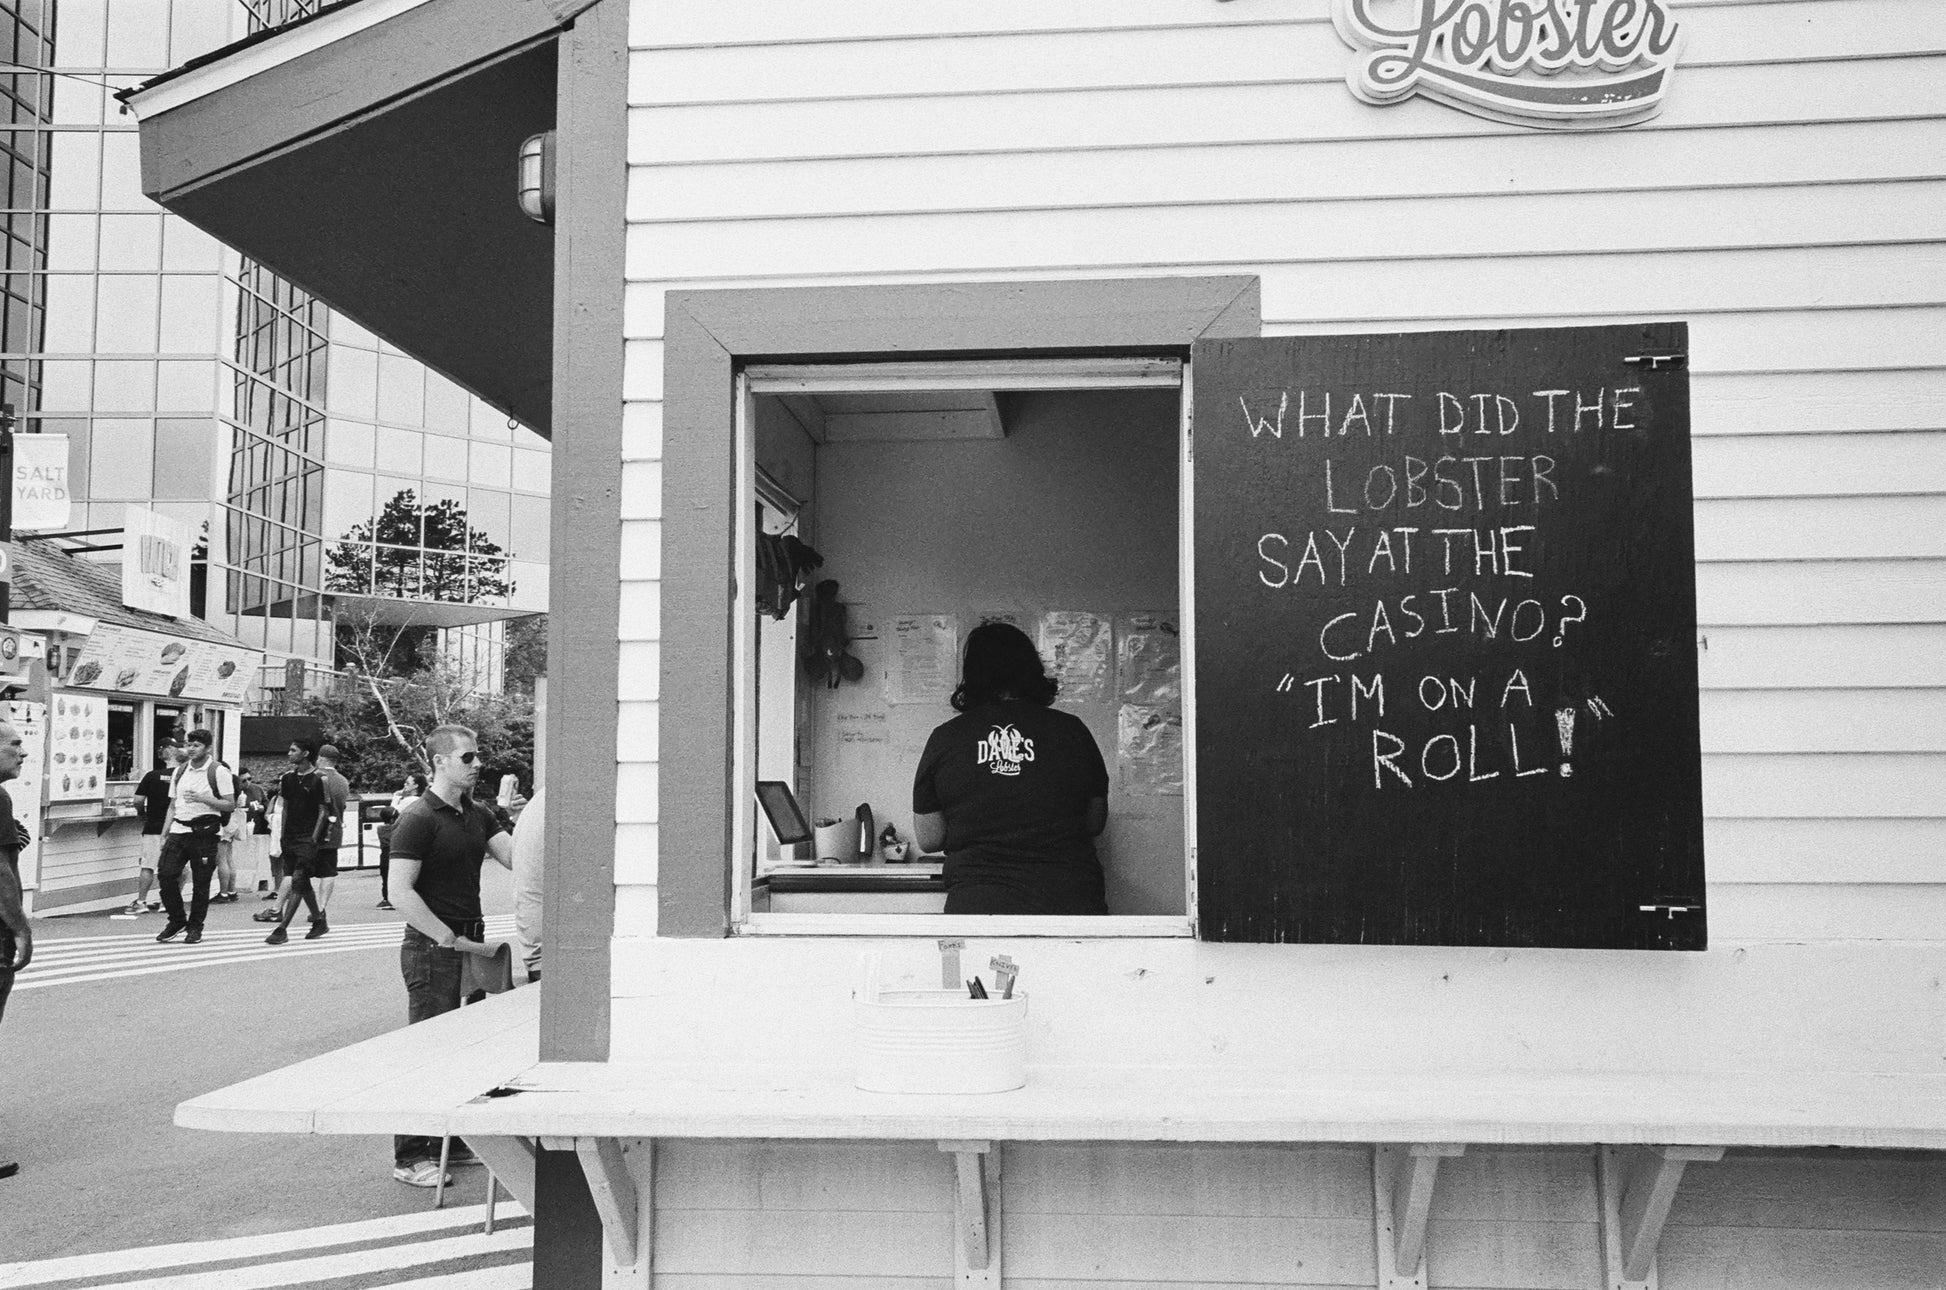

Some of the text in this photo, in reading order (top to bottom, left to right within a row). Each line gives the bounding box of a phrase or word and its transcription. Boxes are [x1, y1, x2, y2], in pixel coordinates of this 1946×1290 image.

[1240, 388, 1640, 438] WHAT DID THE
[17, 466, 65, 481] SALT
[17, 486, 66, 500] YARD
[1326, 454, 1558, 513] LOBSTER
[1257, 524, 1535, 588] SAY AT THE
[1320, 587, 1586, 660] CASINO?
[1418, 675, 1476, 710] ON
[1500, 668, 1532, 708] A
[977, 736, 1035, 765] DAVE'S
